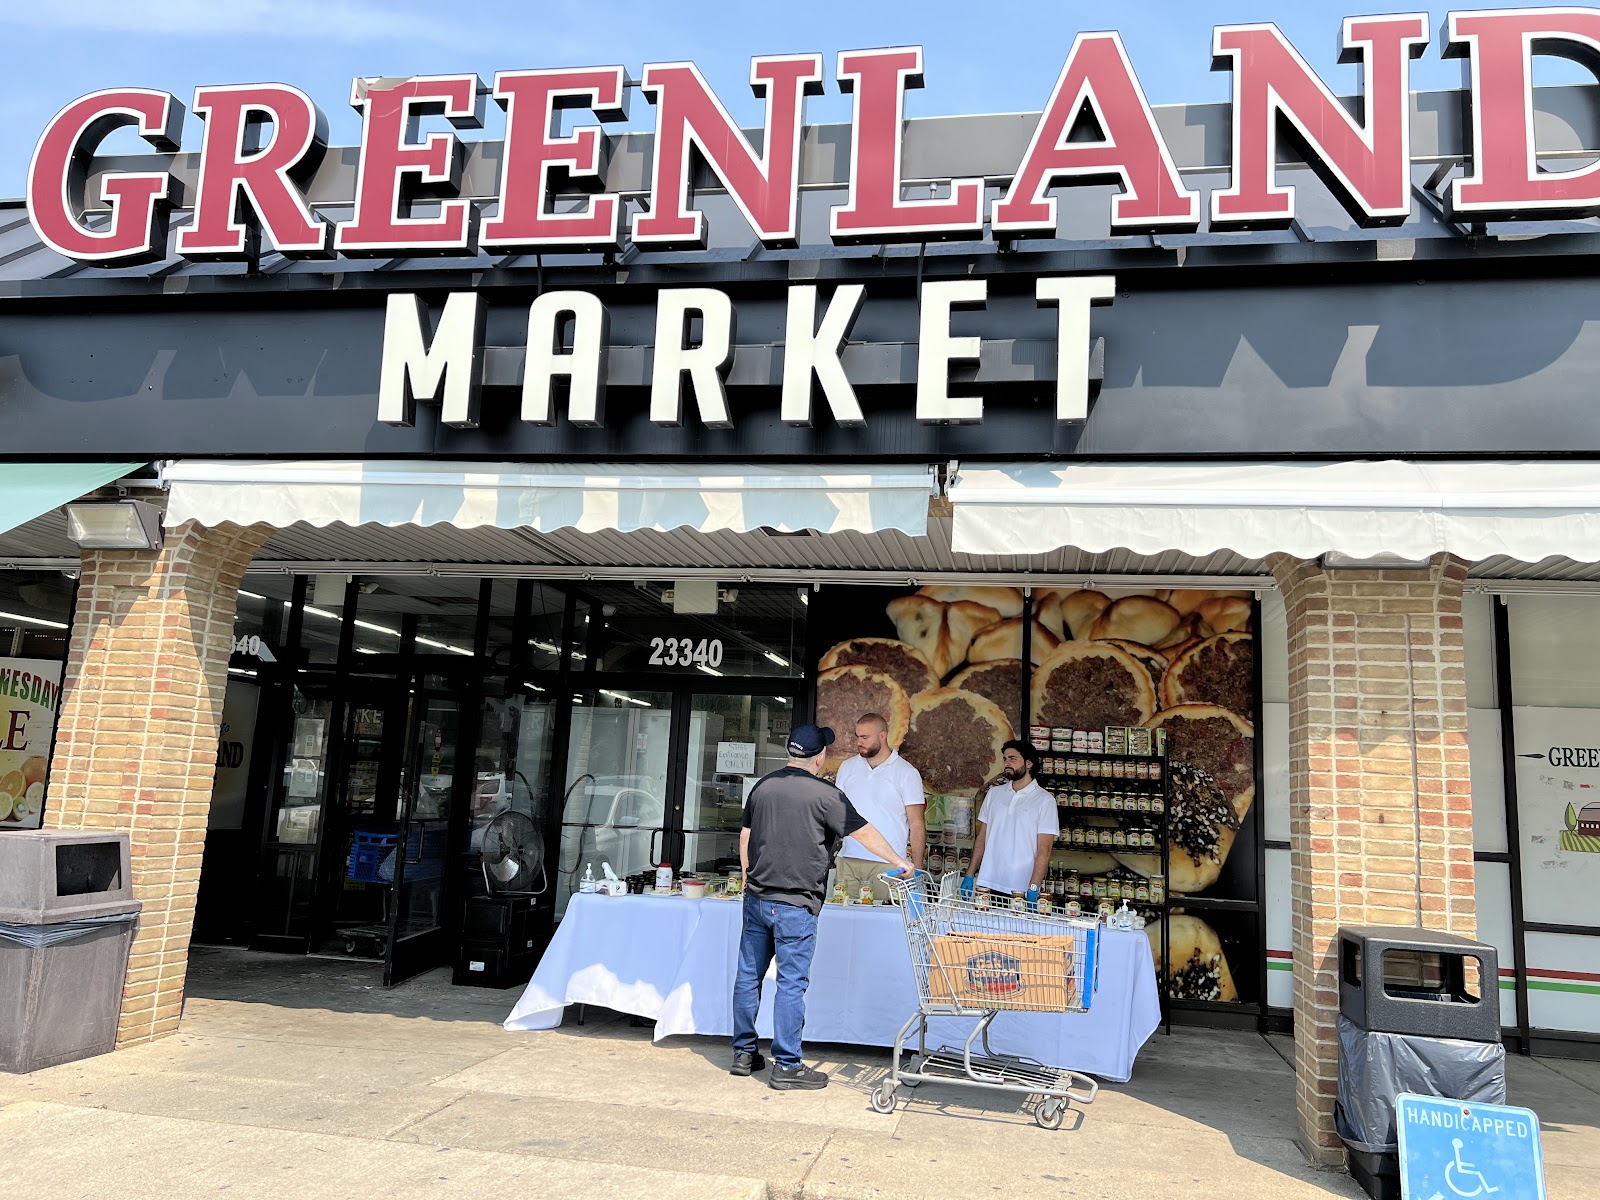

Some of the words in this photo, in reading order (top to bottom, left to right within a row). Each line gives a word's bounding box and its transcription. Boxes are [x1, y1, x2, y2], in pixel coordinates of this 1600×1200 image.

[26, 6, 1600, 264] GREENLAND
[376, 275, 1117, 427] MARKET
[648, 637, 723, 668] 23340
[0, 710, 31, 751] E
[1548, 747, 1600, 768] GREE
[1406, 1106, 1529, 1138] HANDICAPPED
